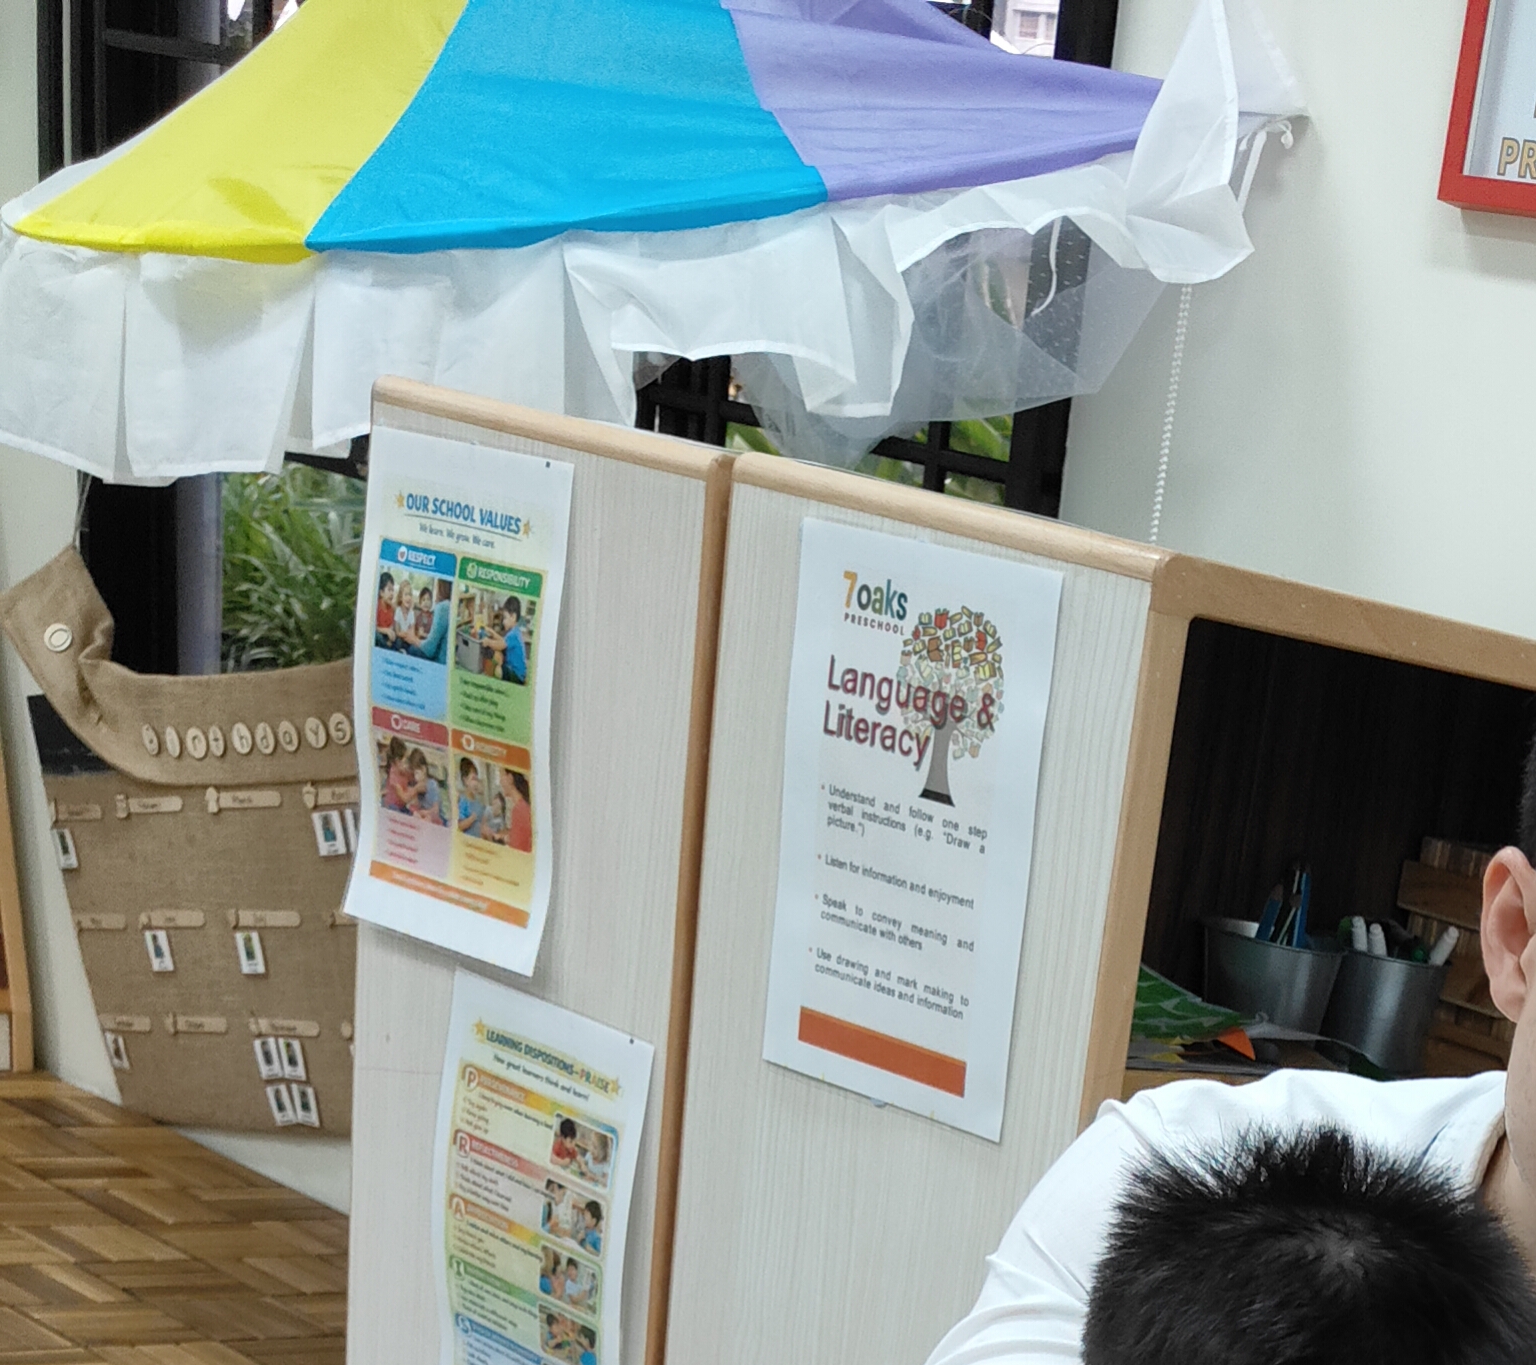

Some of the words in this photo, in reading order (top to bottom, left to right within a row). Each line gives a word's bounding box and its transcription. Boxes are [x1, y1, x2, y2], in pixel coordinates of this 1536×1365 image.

[406, 492, 430, 513] OUR
[431, 497, 476, 523] SCHOOL
[479, 507, 521, 535] VALUES
[843, 570, 908, 621] 7oaks
[844, 612, 905, 636] PRESCHOOL
[828, 654, 968, 730] Language
[976, 693, 995, 732] &
[823, 700, 930, 767] Literacy
[828, 801, 853, 816] verbal
[862, 809, 906, 832] instructions
[979, 844, 986, 854] a
[829, 784, 876, 807] Understand
[883, 801, 900, 815] and
[908, 806, 934, 823] follow
[942, 819, 959, 831] one
[968, 825, 988, 841] step
[825, 854, 847, 871] Listen
[849, 861, 860, 874] for
[862, 864, 907, 889] information
[909, 882, 926, 895] and
[928, 886, 974, 910] enjoyment
[820, 909, 877, 936] communicate
[879, 928, 896, 942] with
[898, 934, 922, 950] others
[822, 893, 847, 912] Speak
[855, 905, 863, 916] to
[872, 911, 902, 930] convey
[911, 924, 948, 946] meaning
[957, 938, 974, 952] and
[815, 962, 871, 989] communicate
[873, 981, 895, 998] ideas
[897, 991, 915, 1005] and
[917, 995, 964, 1020] information
[817, 947, 832, 962] Use
[836, 954, 869, 976] drawing
[874, 968, 891, 981] and
[897, 975, 918, 990] mark
[923, 983, 954, 1005] making
[960, 995, 969, 1007] to
[486, 1029, 523, 1053] LEARNING
